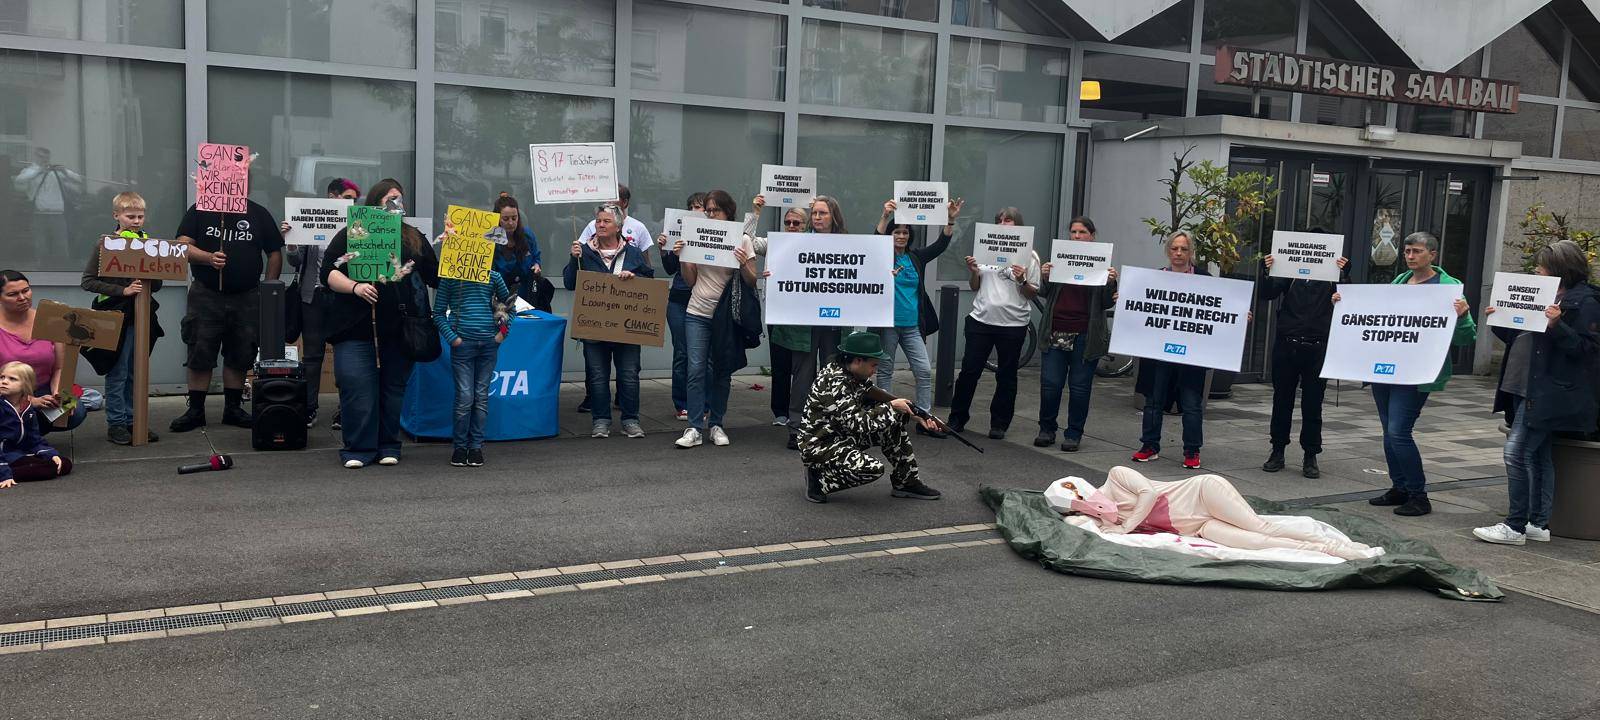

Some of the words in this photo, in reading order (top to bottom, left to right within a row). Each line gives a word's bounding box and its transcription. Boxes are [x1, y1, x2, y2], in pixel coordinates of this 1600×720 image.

[1230, 51, 1396, 98] STÄDTISCHER
[1404, 73, 1516, 110] SAALBAU
[200, 144, 244, 162] GANS
[537, 149, 548, 172] §
[551, 152, 564, 168] 17
[200, 170, 220, 181] WIR
[204, 181, 244, 196] KEINEN
[196, 195, 248, 213] ABSCHUSS!
[350, 207, 368, 220] WIR
[450, 208, 493, 230] GANS
[442, 236, 492, 255] ABSCHUSS
[443, 253, 453, 264] ist
[456, 252, 490, 270] KEINE
[798, 251, 866, 265] GÄNSEKOT
[1288, 255, 1302, 263] AUF
[1303, 256, 1324, 264] LEBEN
[1313, 250, 1335, 258] RECHT
[105, 255, 136, 273] Am
[139, 257, 182, 273] Leben
[1067, 260, 1094, 268] STOPPEN
[440, 263, 491, 282] LÖSUNG!
[805, 267, 826, 279] IST
[828, 268, 858, 280] KEIN
[582, 280, 608, 292] Gebt
[777, 280, 884, 295] TÖTUNGSGRUND!
[1145, 288, 1223, 308] WILDGÄNSE
[1509, 293, 1520, 301] IST
[642, 305, 656, 314] den
[1125, 299, 1169, 316] HABEN
[1171, 305, 1193, 319] EIN
[1195, 309, 1238, 324] RECHT
[624, 318, 660, 333] CHANCE
[1144, 316, 1171, 330] AUF
[1172, 320, 1214, 336] LEBEN
[1341, 313, 1448, 329] GÄNSETÖTUNGEN
[1361, 329, 1420, 343] STOPPEN
